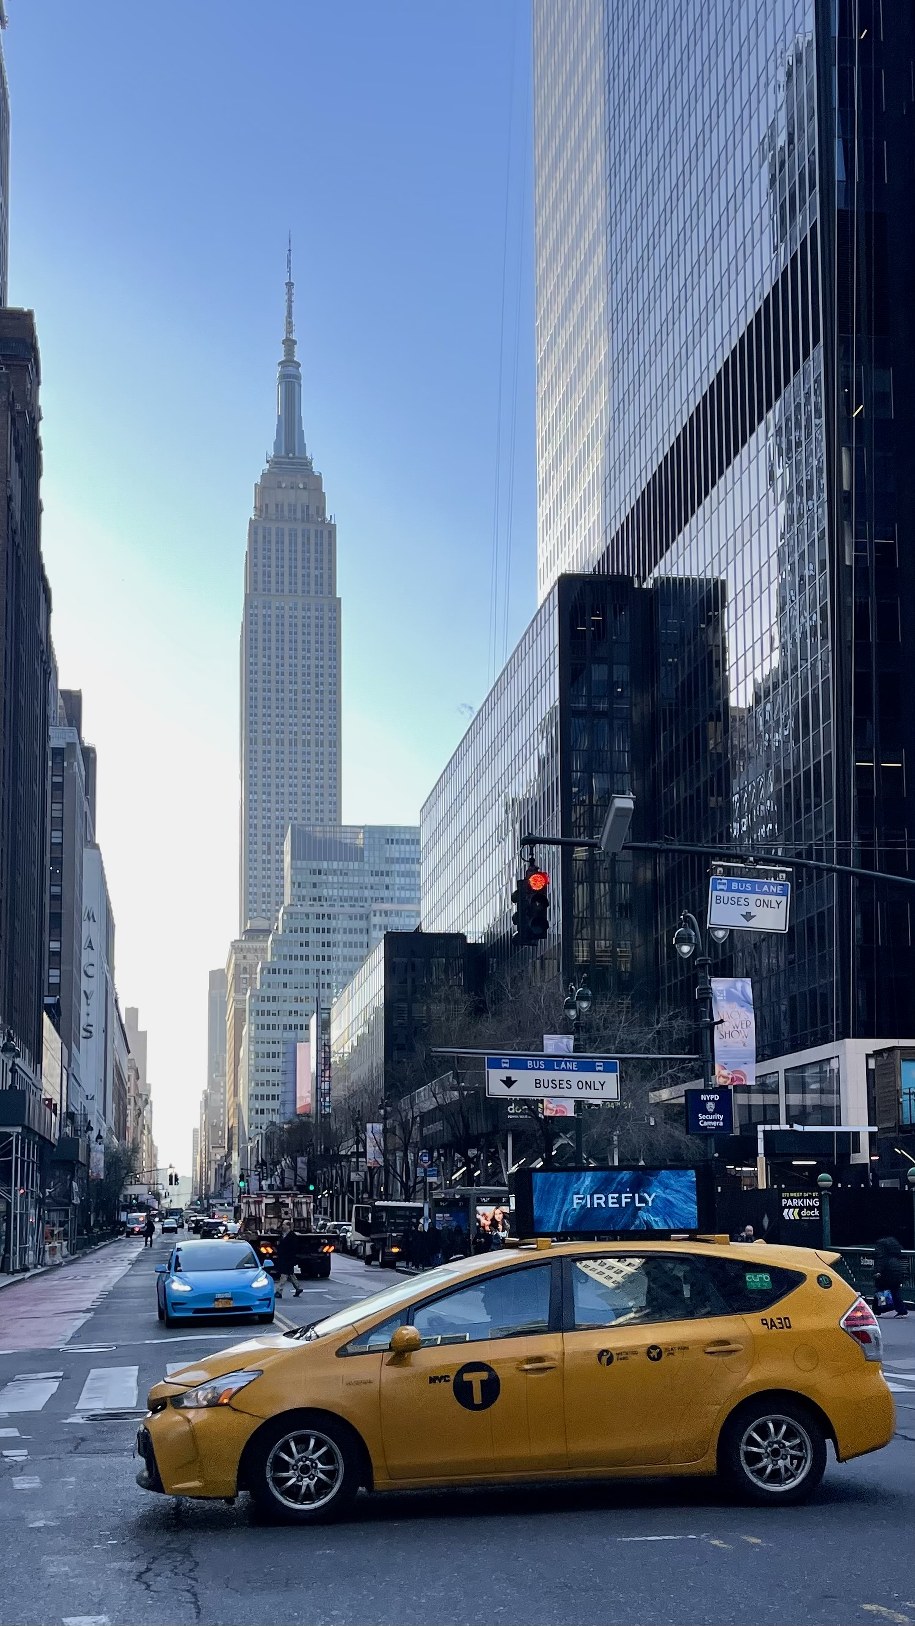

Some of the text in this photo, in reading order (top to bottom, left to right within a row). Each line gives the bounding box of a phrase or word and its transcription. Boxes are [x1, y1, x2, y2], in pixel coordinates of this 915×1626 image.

[731, 882, 783, 893] BUS LANE
[715, 895, 783, 910] BUSES ONLY
[719, 1029, 749, 1039] SHOW
[527, 1060, 578, 1070] BUS LANE
[534, 1078, 606, 1091] BUSES ONLY
[698, 1113, 724, 1121] Security
[573, 1193, 656, 1208] FIREFLY
[782, 1198, 820, 1207] PARKING
[800, 1208, 820, 1216] dock
[428, 1371, 489, 1405] NYC T
